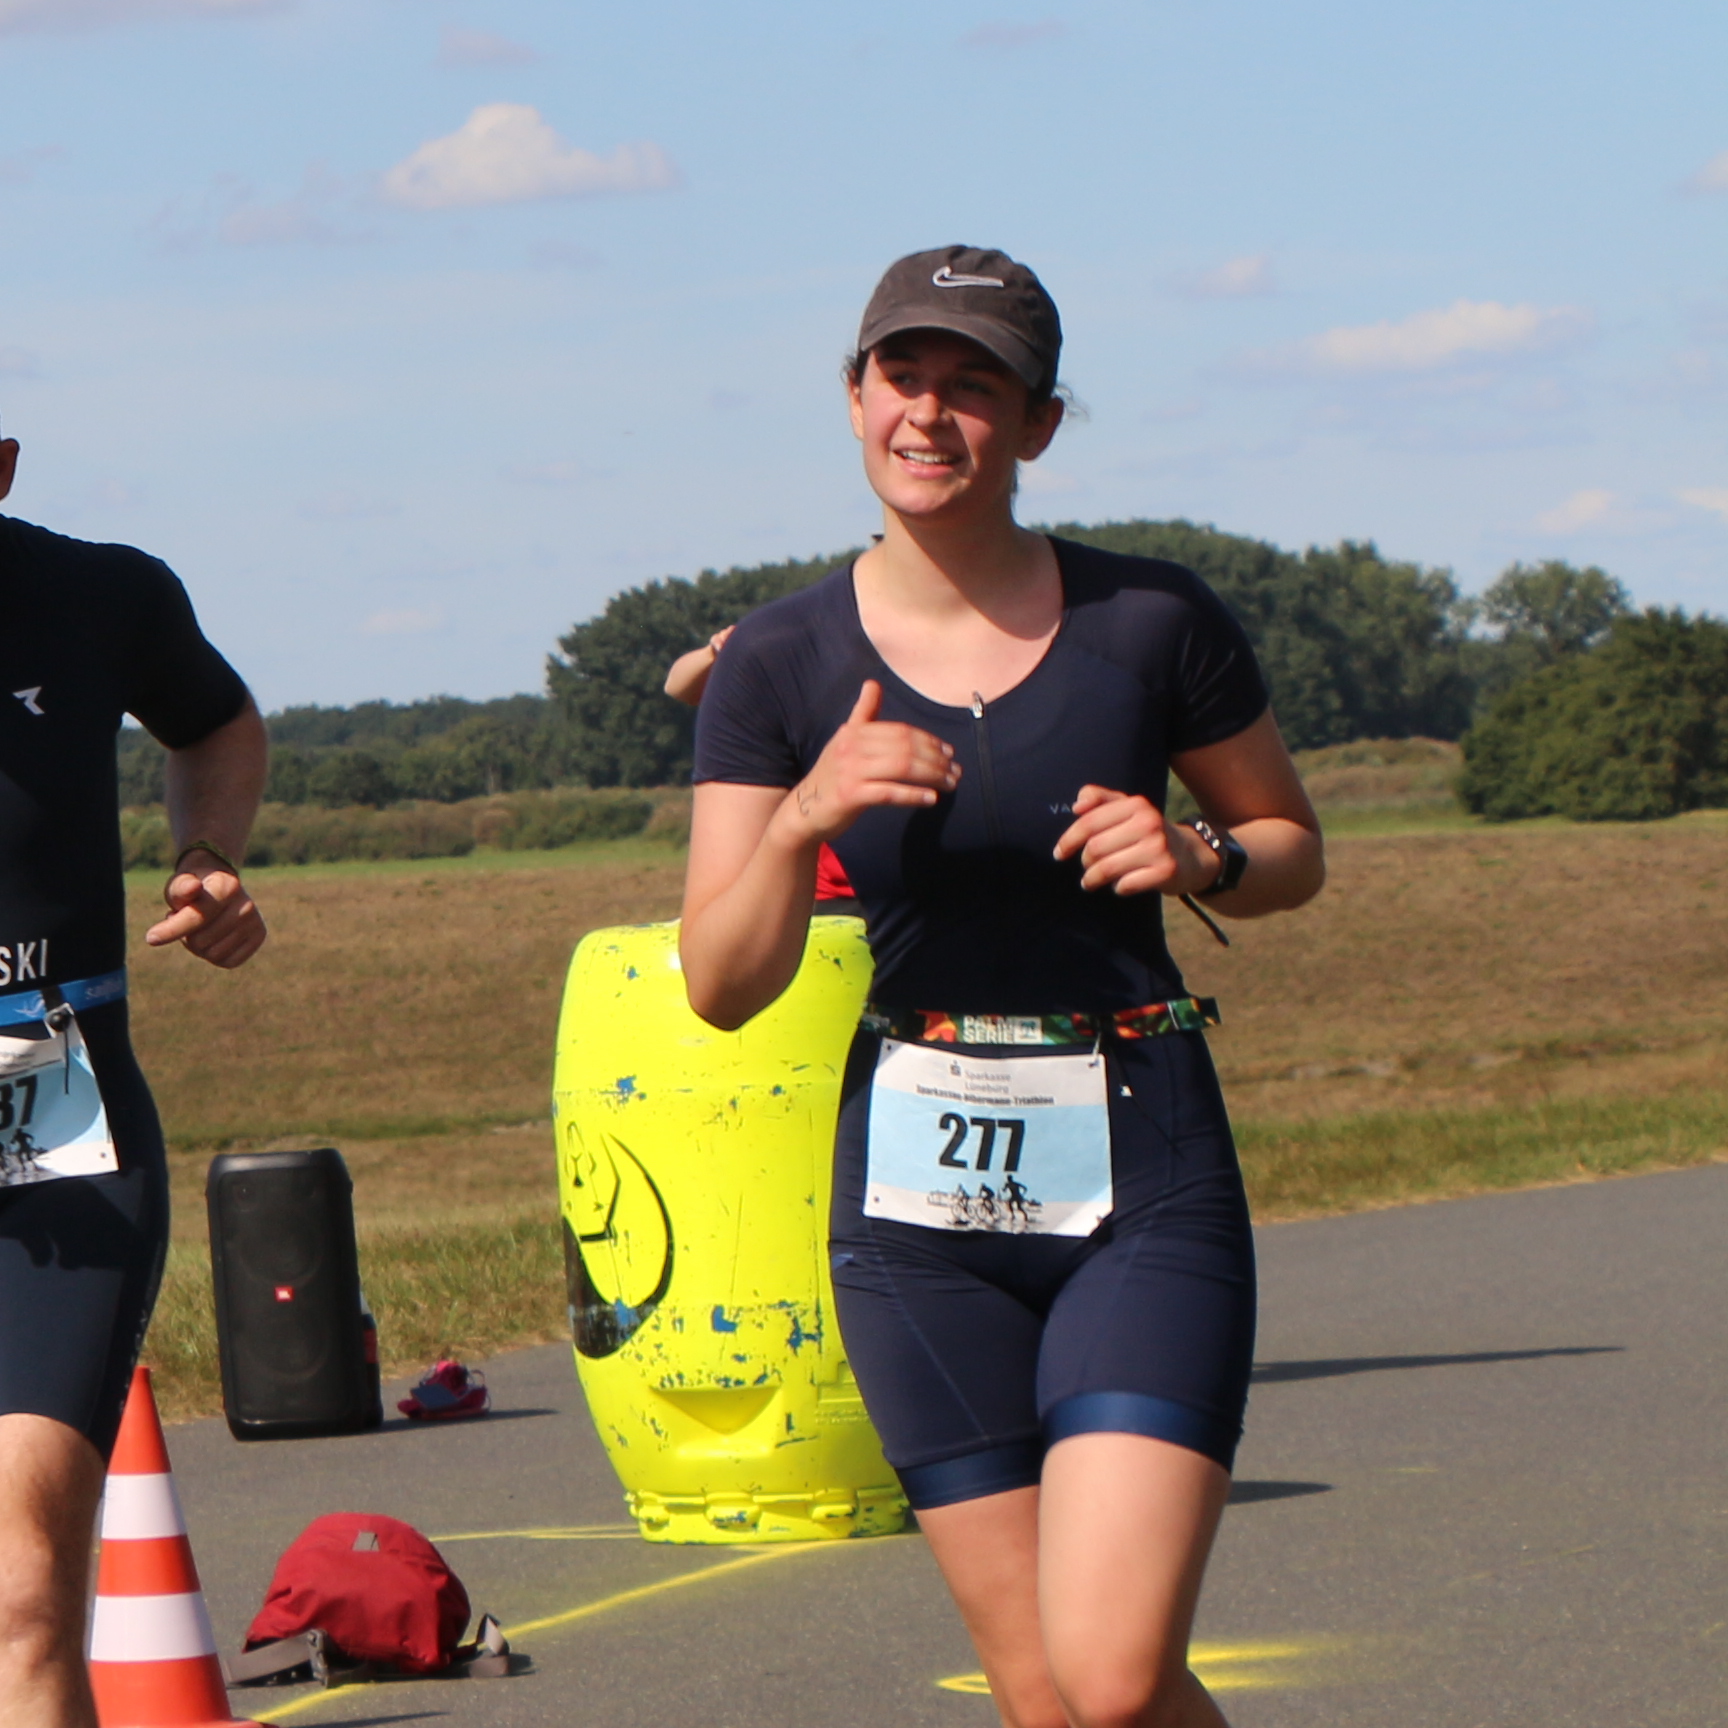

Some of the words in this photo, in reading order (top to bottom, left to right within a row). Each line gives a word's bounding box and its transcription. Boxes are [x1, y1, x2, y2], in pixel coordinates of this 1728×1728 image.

[1049, 803, 1072, 814] VA
[963, 1027, 1014, 1044] SERIE
[938, 1112, 1026, 1172] 277
